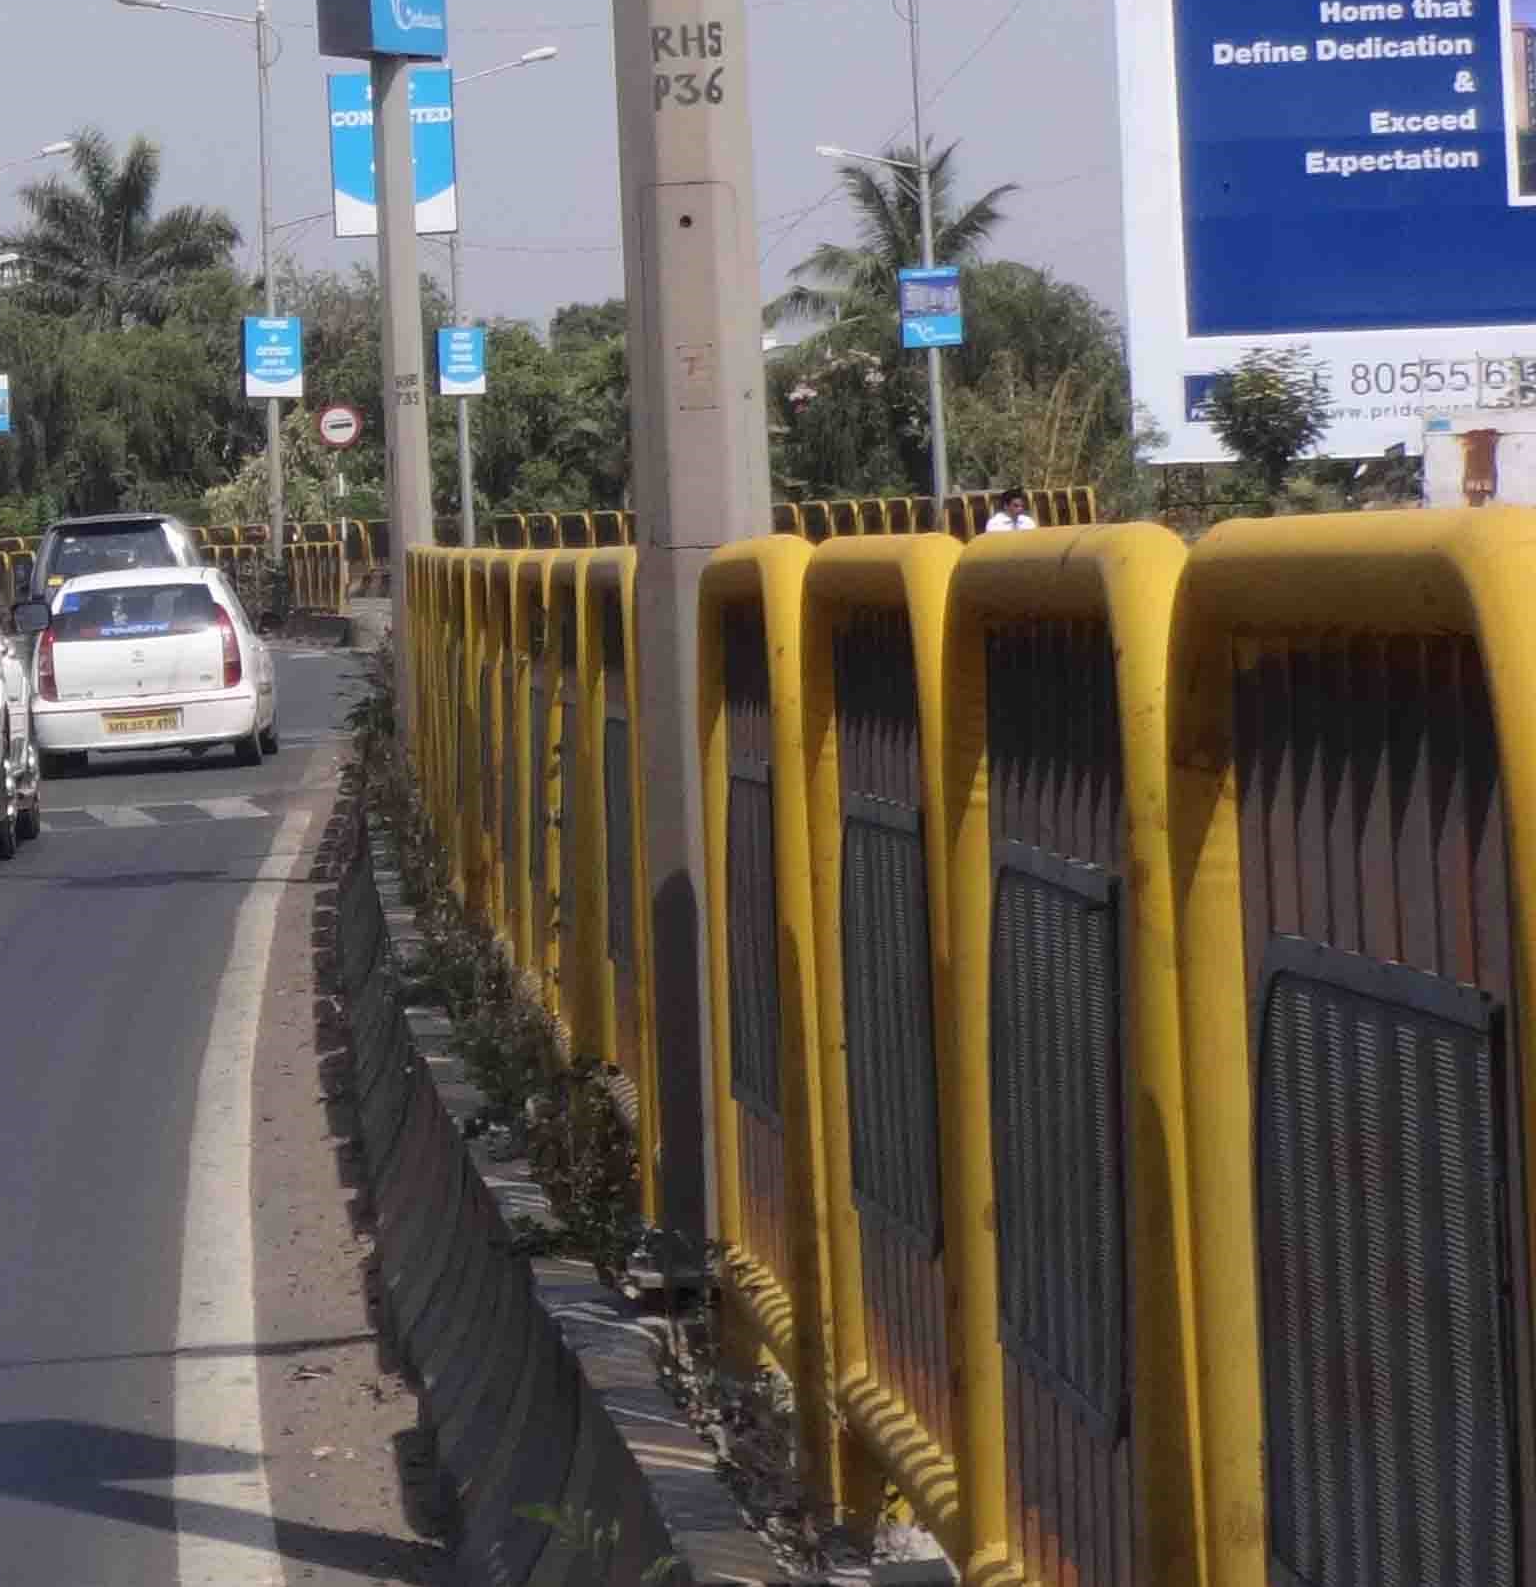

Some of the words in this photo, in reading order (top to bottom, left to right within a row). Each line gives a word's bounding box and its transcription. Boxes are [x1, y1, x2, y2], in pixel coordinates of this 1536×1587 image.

[1319, 1, 1404, 24] Home
[651, 21, 724, 63] RHS
[1212, 42, 1308, 66] Define
[1315, 34, 1474, 62] Dedication
[654, 66, 725, 110] P36
[1453, 70, 1476, 93] &
[1369, 109, 1477, 134] Exceed
[1304, 147, 1479, 177] Expectation
[1351, 362, 1472, 396] 80555
